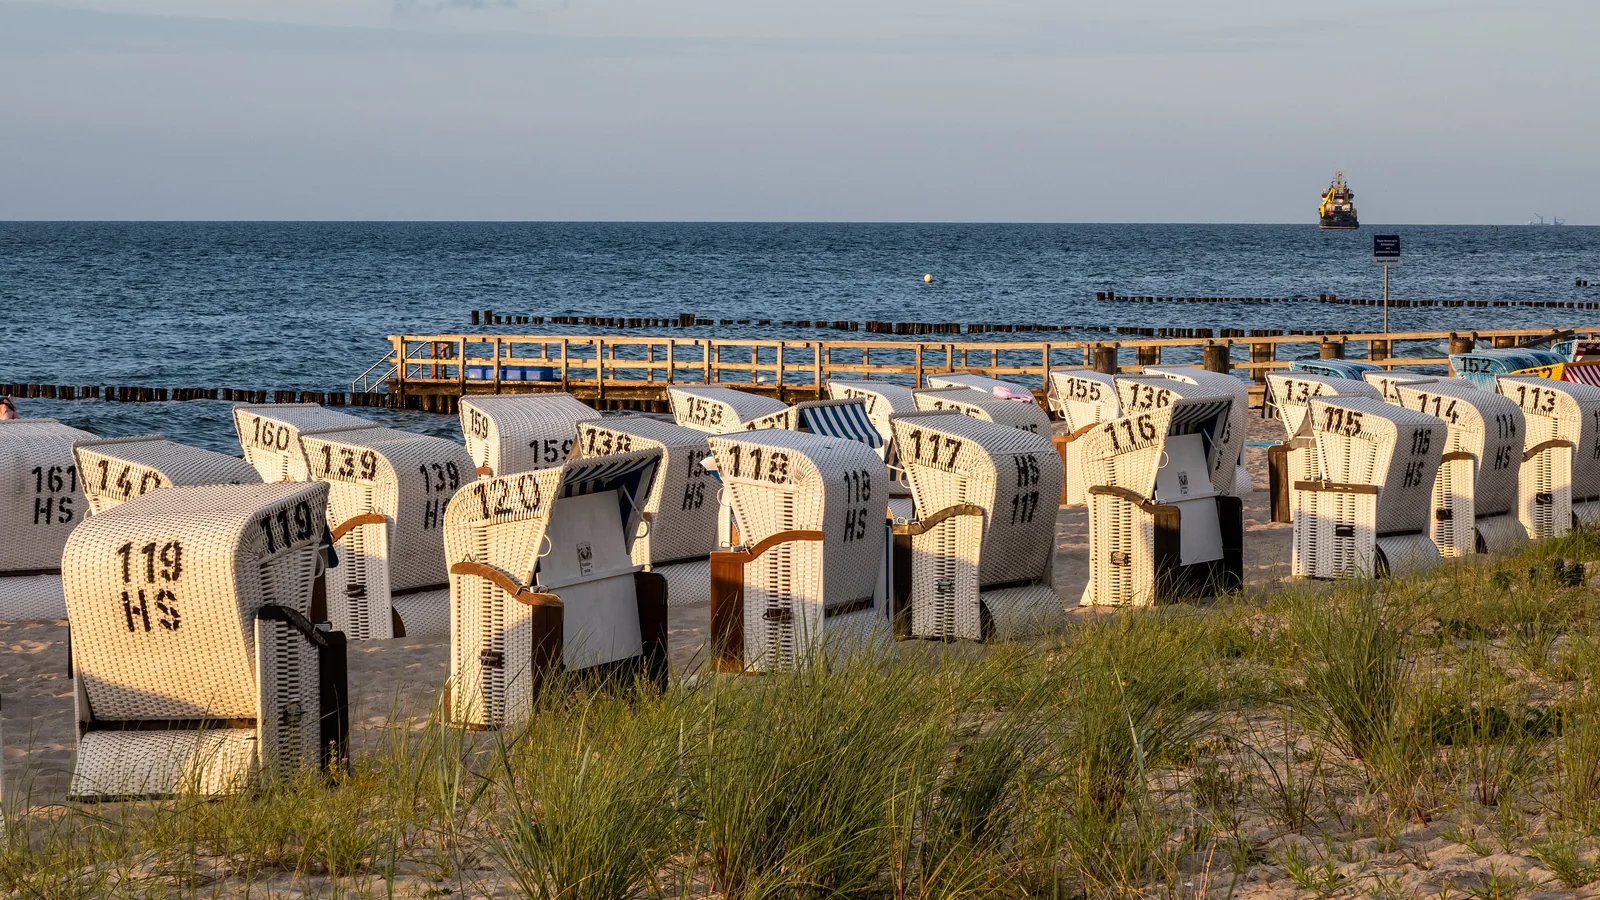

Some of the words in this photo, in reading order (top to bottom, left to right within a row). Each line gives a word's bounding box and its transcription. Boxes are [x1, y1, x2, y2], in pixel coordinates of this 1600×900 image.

[1460, 356, 1492, 374] 152
[1067, 377, 1101, 401] 155
[1130, 383, 1171, 409] 136
[1517, 385, 1556, 413] 113
[469, 408, 489, 439] 159
[686, 396, 723, 424] 158
[1325, 406, 1363, 438] 115
[1417, 393, 1459, 425] 114
[253, 416, 290, 451] 160
[586, 428, 632, 455] 138
[1104, 414, 1156, 450] 116
[1411, 428, 1432, 455] 115
[1496, 413, 1516, 439] 114
[321, 443, 377, 481] 139
[728, 444, 788, 485] 118
[910, 429, 962, 468] 117
[1494, 445, 1511, 471] HS
[31, 466, 76, 493] 161
[420, 460, 460, 494] 139
[844, 468, 871, 504] 118
[1403, 461, 1424, 489] HS
[33, 496, 74, 525] HS
[474, 474, 541, 520] 120
[682, 482, 705, 511] HS
[1011, 490, 1040, 526] 117
[260, 501, 313, 554] 119
[843, 507, 868, 543] HS
[117, 540, 183, 584] 119
[121, 588, 181, 632] HS
